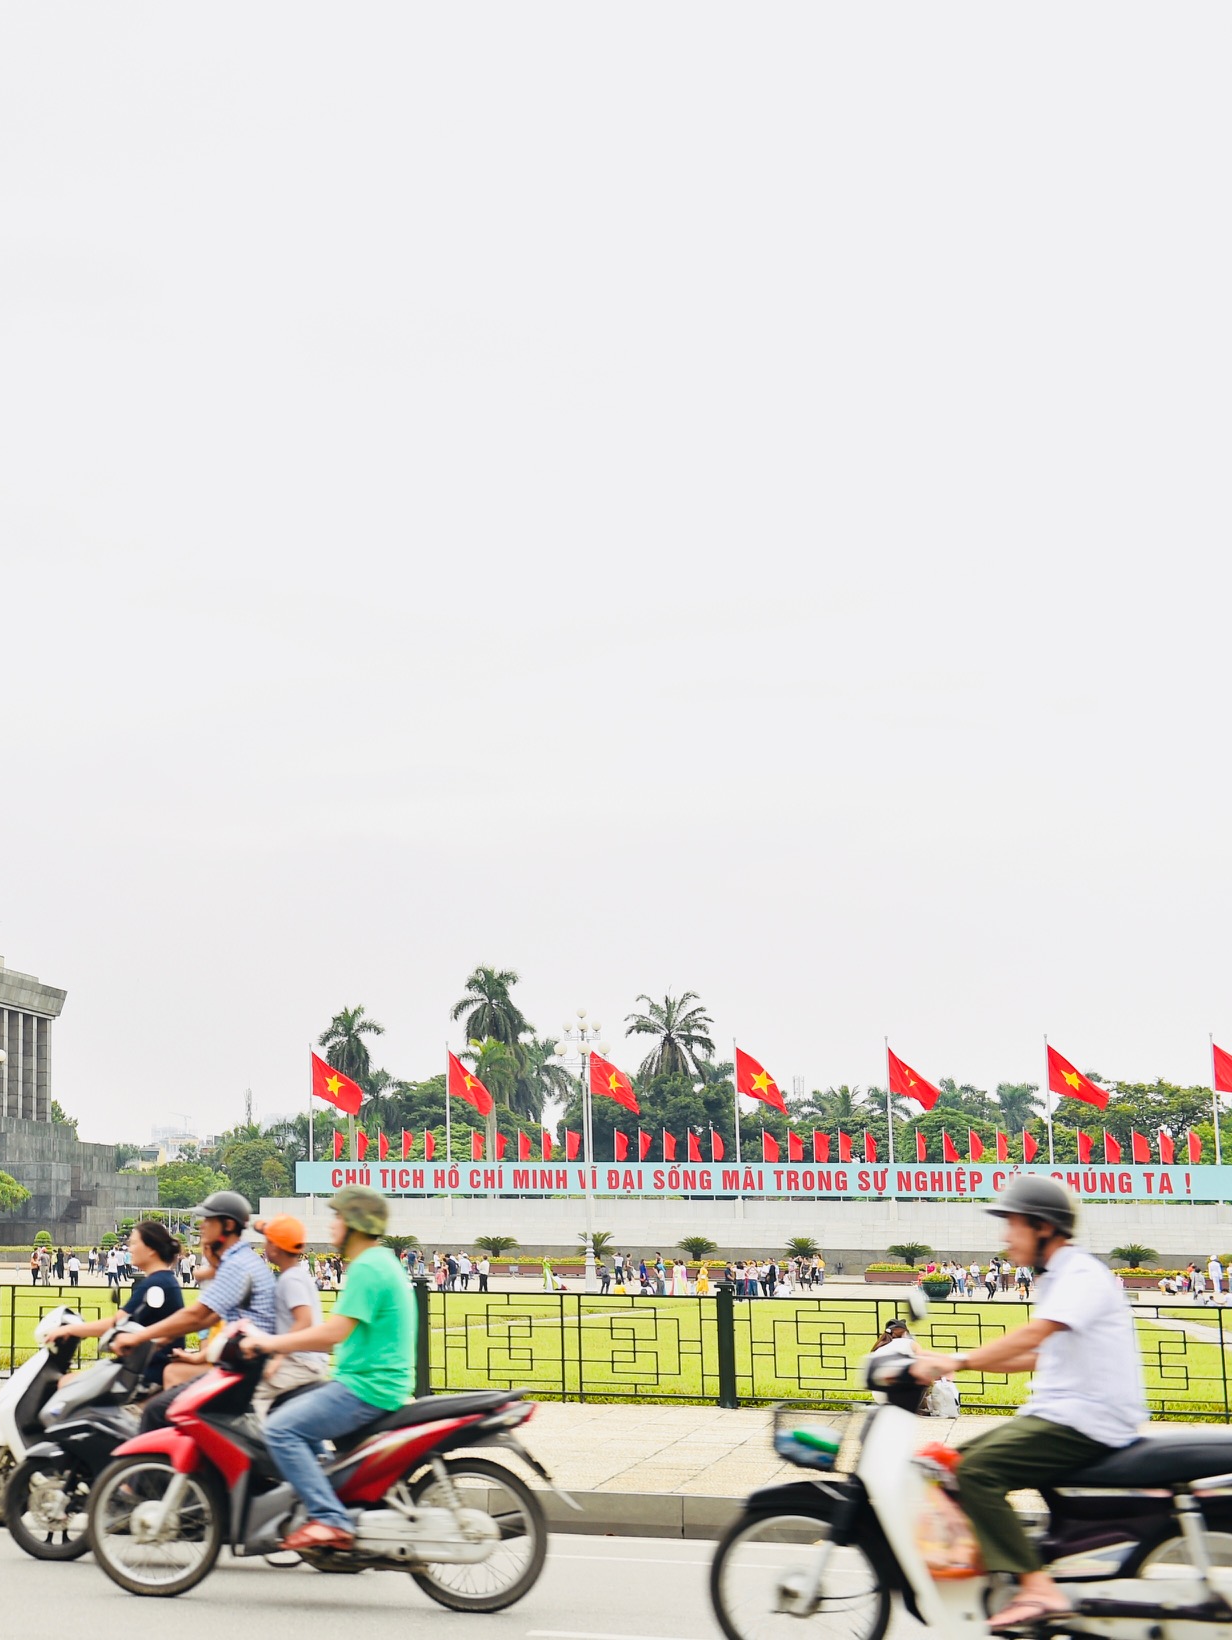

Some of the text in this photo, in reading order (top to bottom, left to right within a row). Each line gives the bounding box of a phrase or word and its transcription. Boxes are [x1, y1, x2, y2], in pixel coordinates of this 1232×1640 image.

[331, 1163, 371, 1189] CHỦ
[379, 1169, 425, 1192] TỊCH
[433, 1162, 460, 1189] HỒ
[469, 1165, 504, 1190] CHÍ
[512, 1169, 568, 1190] MINH
[607, 1169, 643, 1194] ĐẠI
[653, 1163, 712, 1191] SỐNG
[722, 1166, 764, 1191] MÃI
[773, 1170, 848, 1191] TRONG
[858, 1167, 889, 1196] SỰ
[896, 1167, 983, 1196] NGHIỆP
[1142, 1173, 1174, 1195] TA
